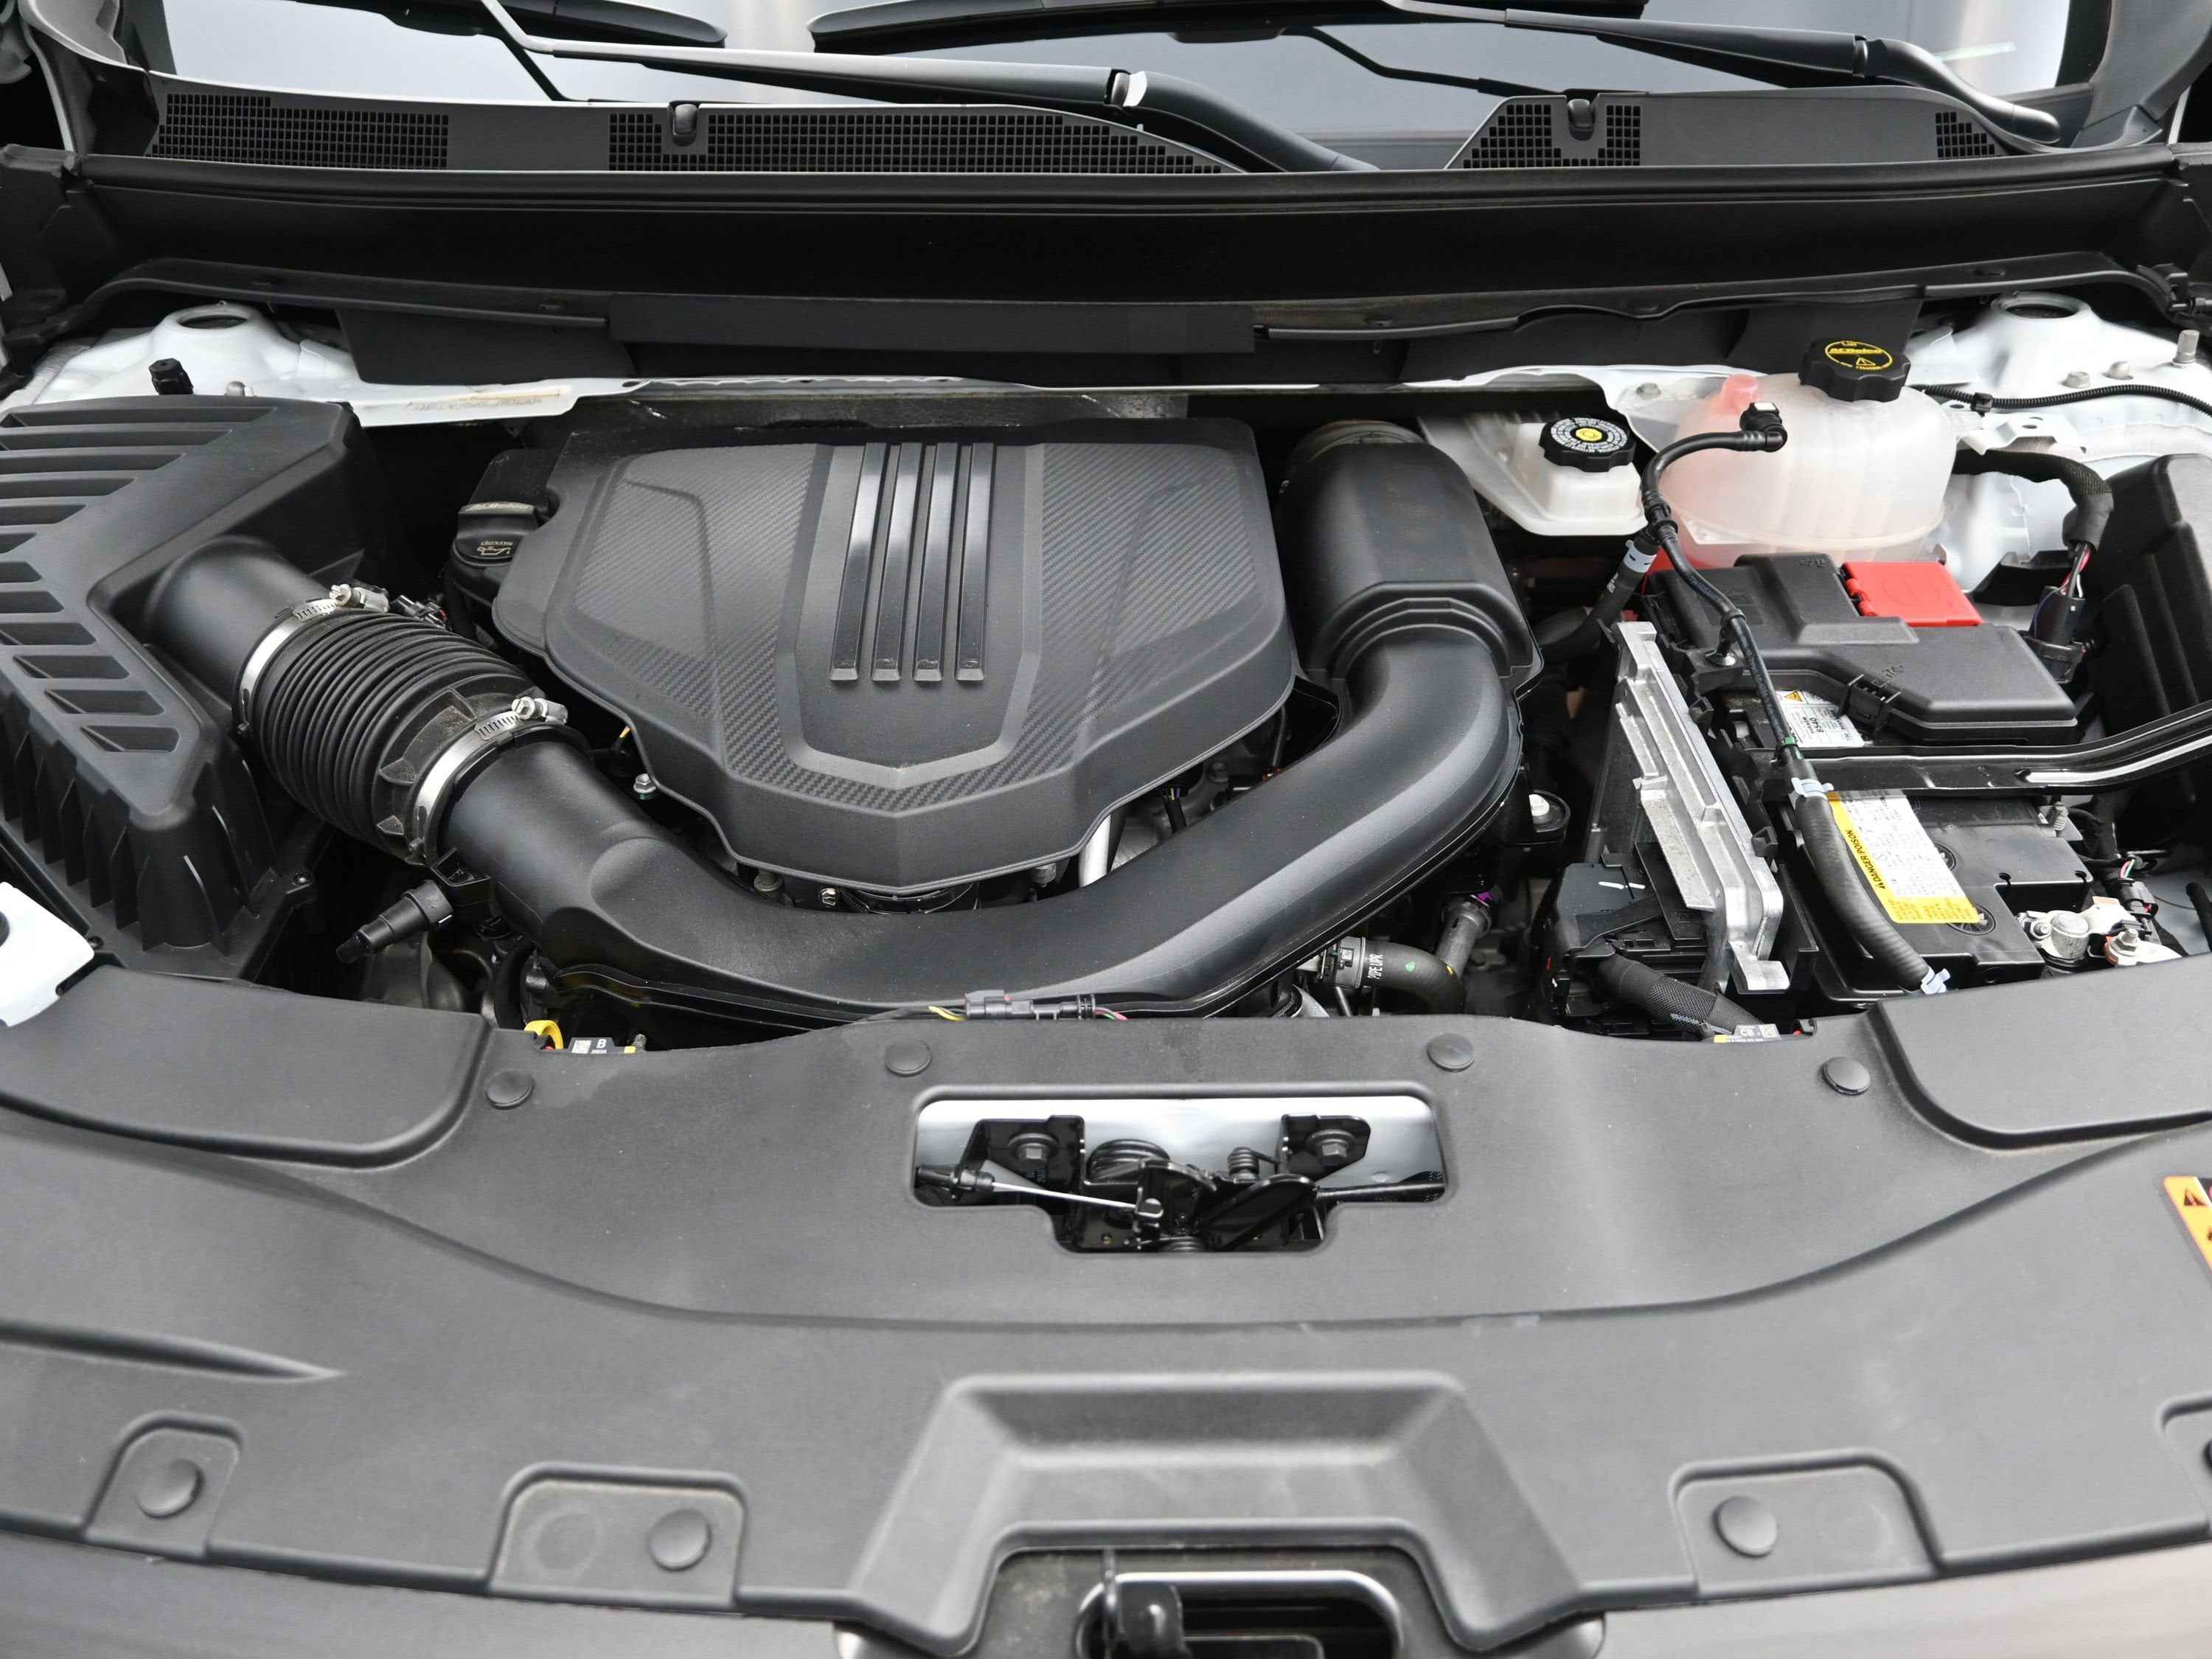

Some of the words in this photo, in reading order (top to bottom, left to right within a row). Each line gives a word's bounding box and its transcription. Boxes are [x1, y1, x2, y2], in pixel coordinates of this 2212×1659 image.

[1846, 830, 1863, 854] POISON
[1860, 855, 1882, 882] DANGER
[1369, 953, 1384, 967] UPR
[1367, 966, 1382, 980] PIPE
[597, 1038, 607, 1048] B
